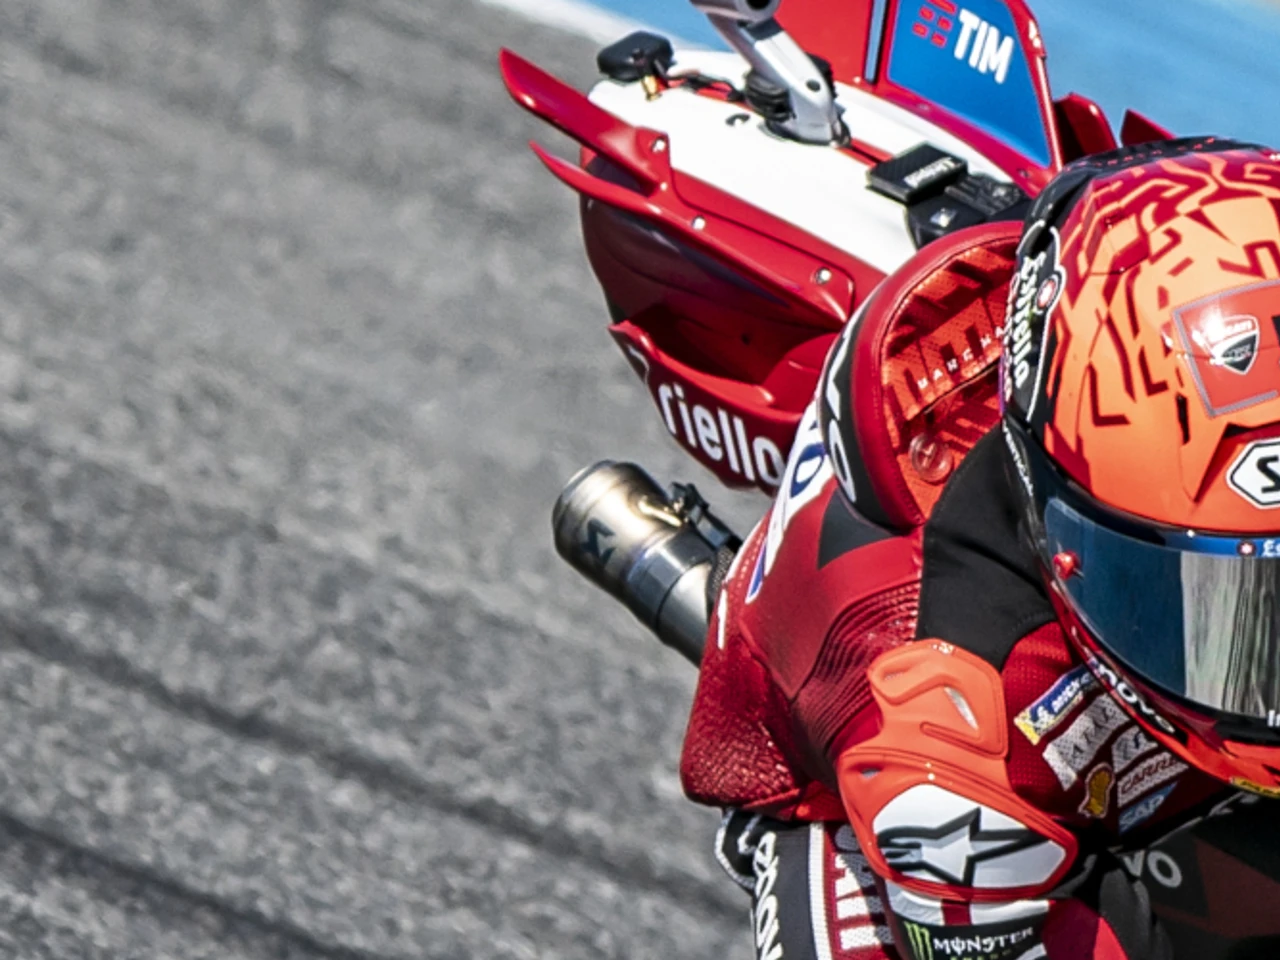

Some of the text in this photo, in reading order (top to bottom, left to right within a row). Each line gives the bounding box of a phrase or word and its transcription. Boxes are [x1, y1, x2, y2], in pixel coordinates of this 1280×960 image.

[954, 8, 1014, 84] TIM
[658, 382, 786, 488] riello
[933, 926, 1034, 955] MONSTER
